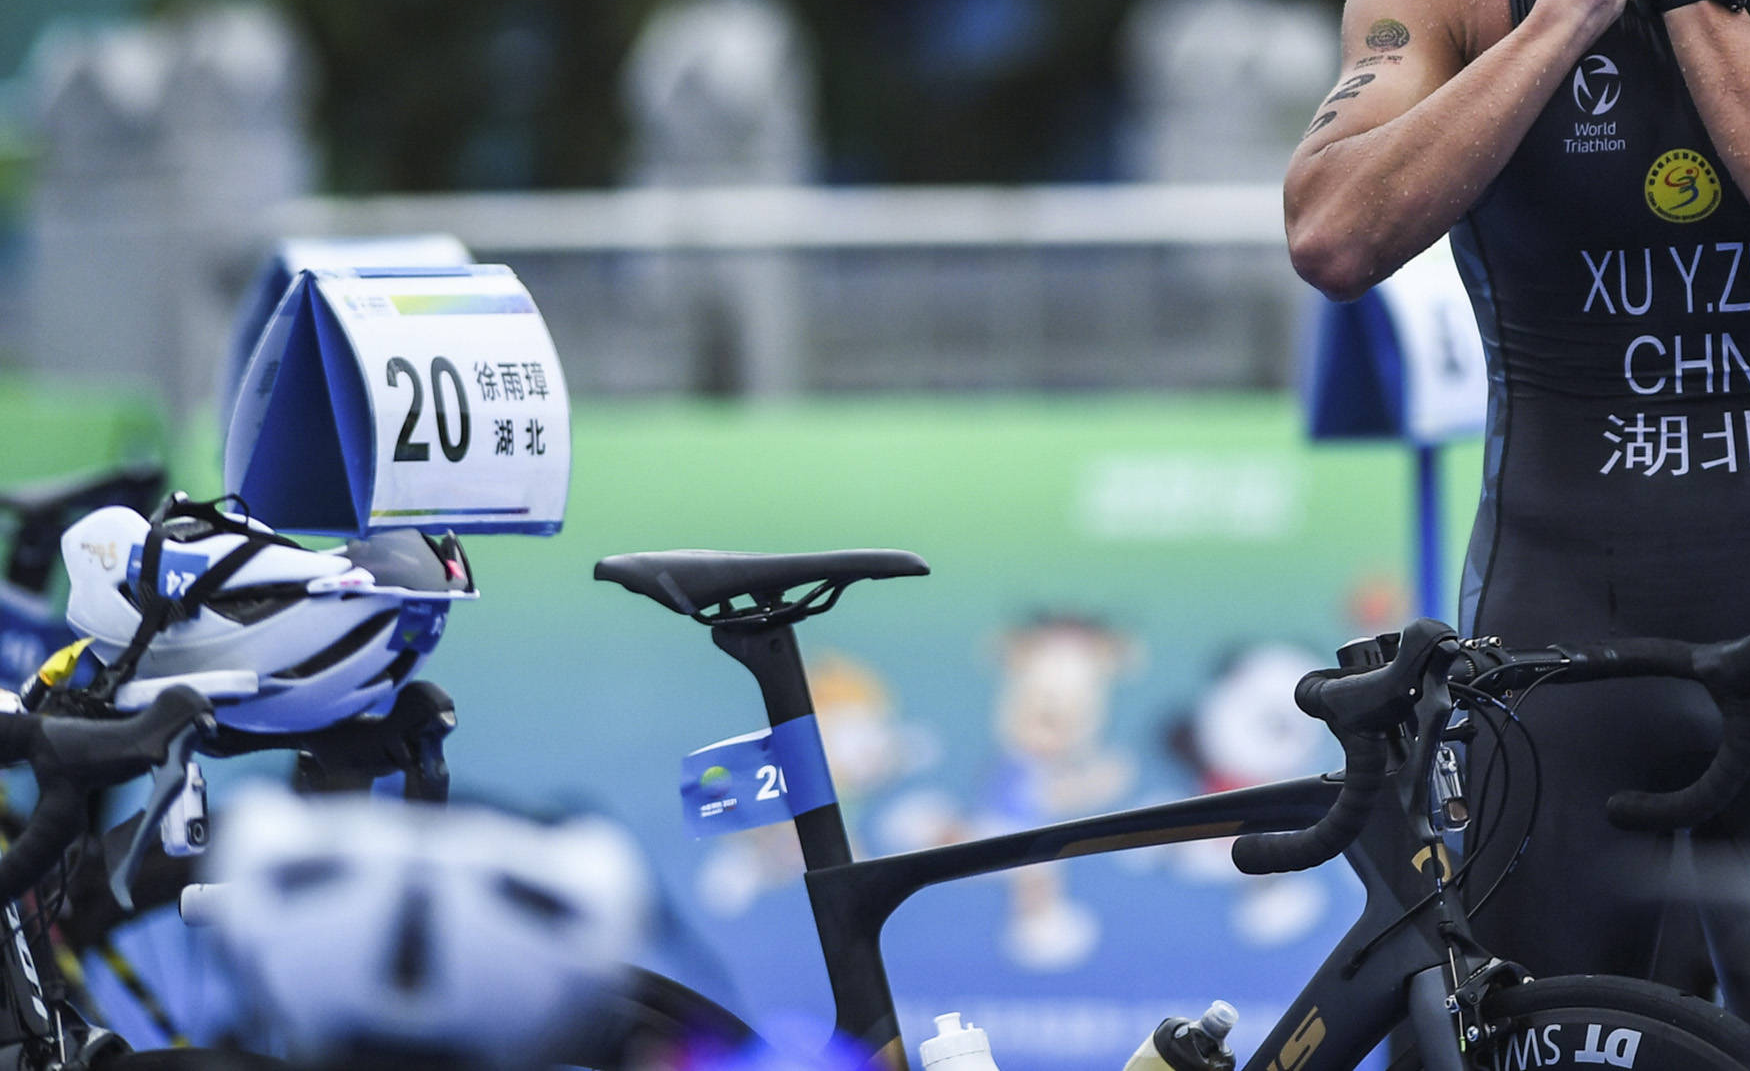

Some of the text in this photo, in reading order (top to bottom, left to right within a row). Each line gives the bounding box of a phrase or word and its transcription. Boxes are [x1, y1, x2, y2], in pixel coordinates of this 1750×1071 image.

[1563, 138, 1626, 154] Triathlon
[1574, 121, 1617, 137] World
[1580, 248, 1653, 316] XU
[385, 355, 472, 463] 20
[494, 418, 546, 457] 湖北
[1574, 1023, 1642, 1070] DT
